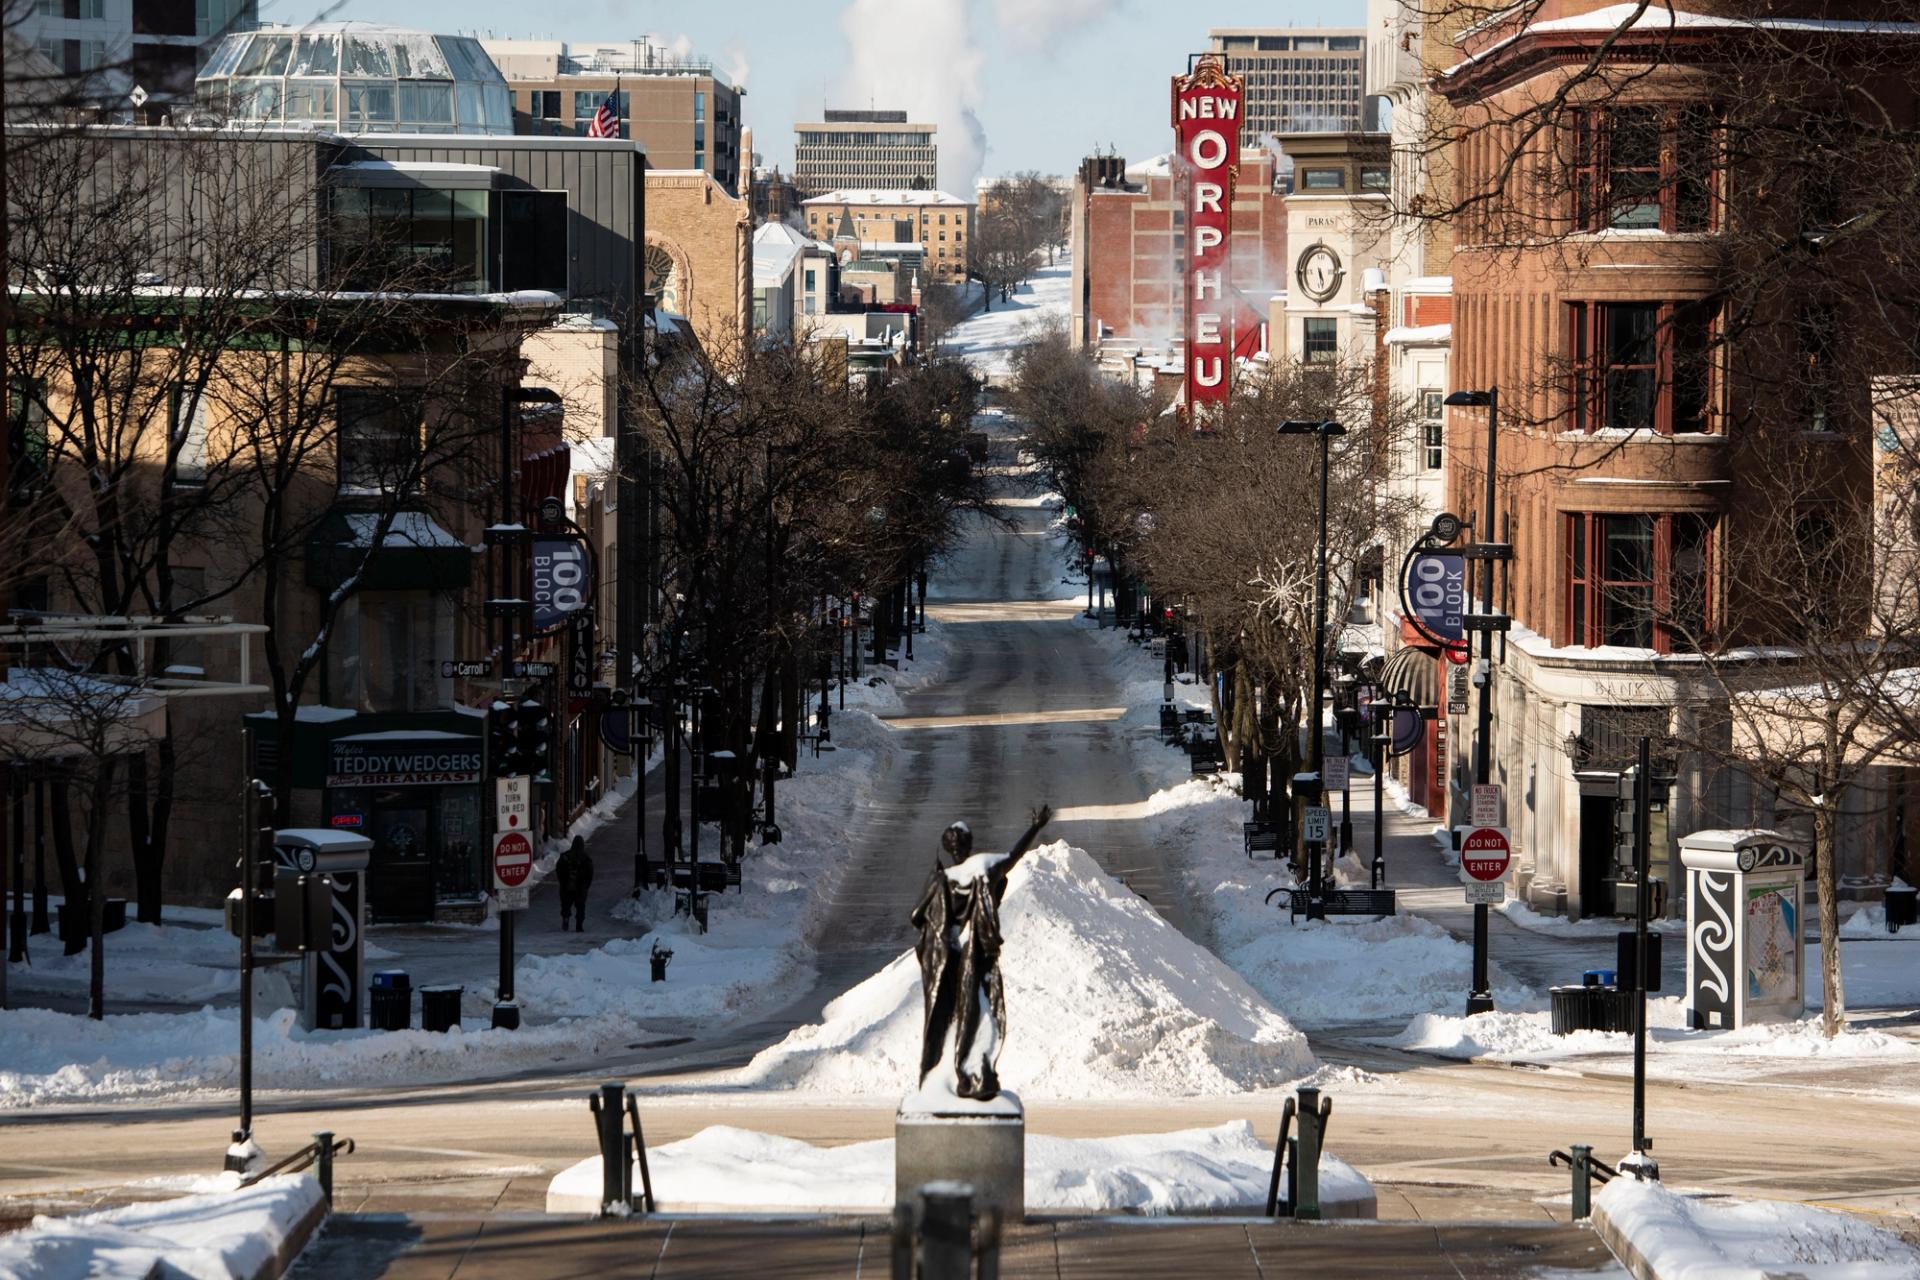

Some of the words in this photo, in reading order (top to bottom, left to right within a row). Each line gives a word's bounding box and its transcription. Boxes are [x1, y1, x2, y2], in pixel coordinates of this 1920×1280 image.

[1179, 96, 1238, 121] NEW
[1308, 217, 1335, 226] PARAS
[534, 555, 551, 613] BLOCK
[552, 544, 582, 612] 100
[1416, 558, 1446, 622] 100
[1446, 570, 1463, 627] BLOCK
[574, 616, 590, 688] PIANO
[458, 662, 484, 676] Carroll
[527, 663, 548, 676] Mifflin
[569, 689, 592, 698] BAR
[1594, 681, 1645, 697] BANK
[332, 743, 364, 756] Myles
[333, 753, 481, 774] TEDDYWEDGERS
[361, 772, 477, 784] BREAKFAST
[507, 782, 518, 792] NO
[505, 794, 521, 803] TURN
[501, 805, 510, 814] ON
[512, 803, 525, 813] RED
[331, 814, 361, 826] OPEN
[1309, 826, 1324, 838] 15
[500, 844, 511, 854] DO
[511, 842, 526, 853] NOT
[1469, 838, 1482, 848] DO
[1484, 838, 1503, 848] NOT
[500, 866, 526, 878] ENTER
[1470, 862, 1501, 872] ENTER
